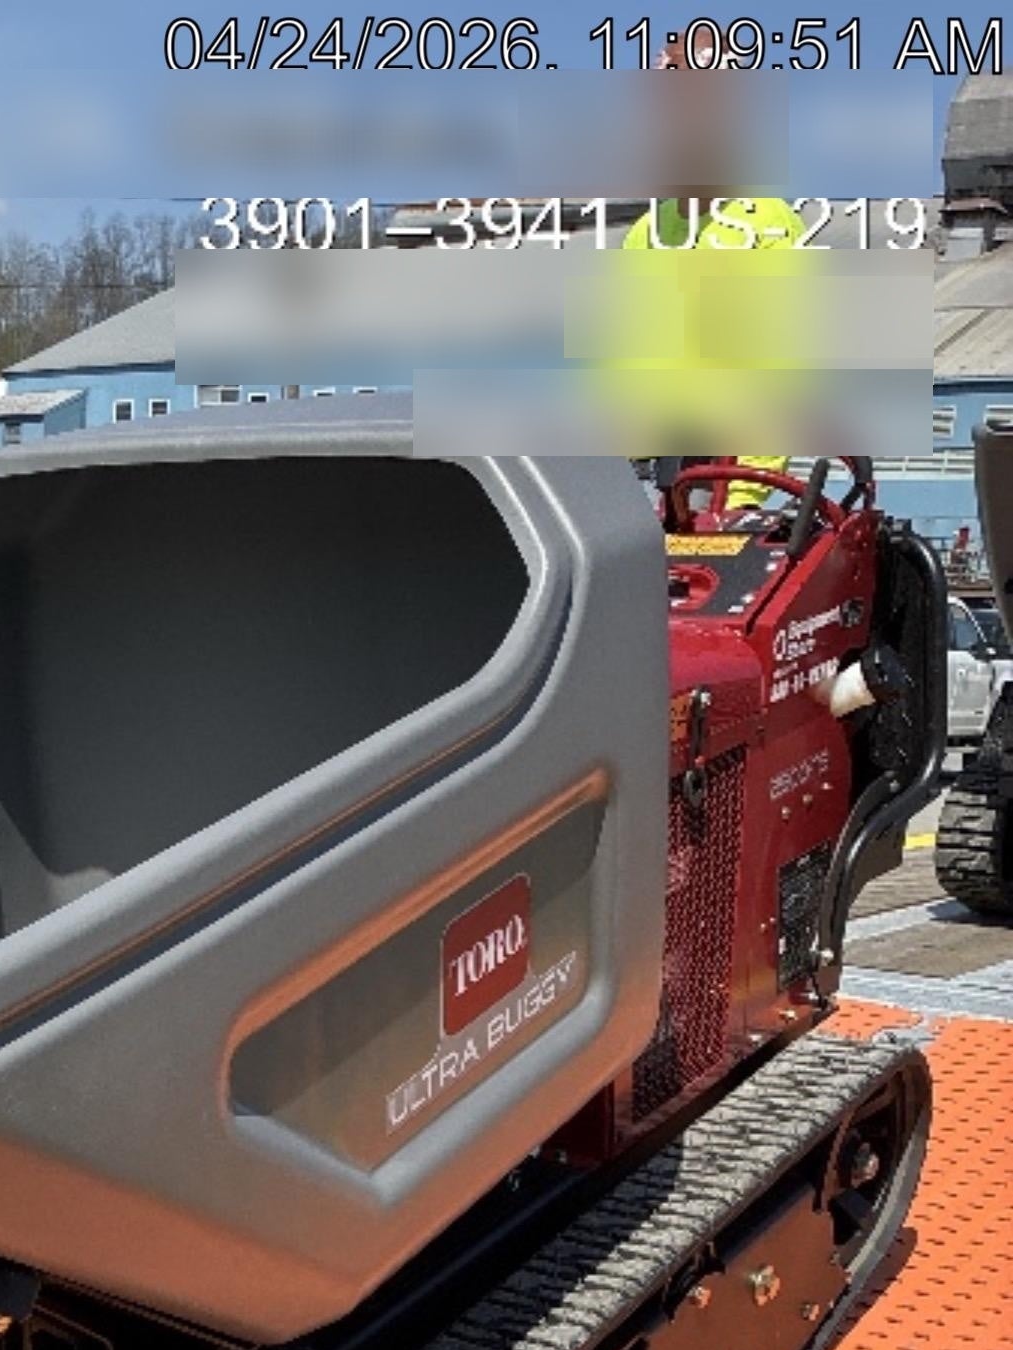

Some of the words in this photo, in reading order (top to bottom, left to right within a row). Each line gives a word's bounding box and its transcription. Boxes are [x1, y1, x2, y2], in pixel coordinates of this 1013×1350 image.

[448, 914, 527, 997] TORO
[387, 1038, 480, 1126] ULTRA
[487, 950, 577, 1051] BUGGY
